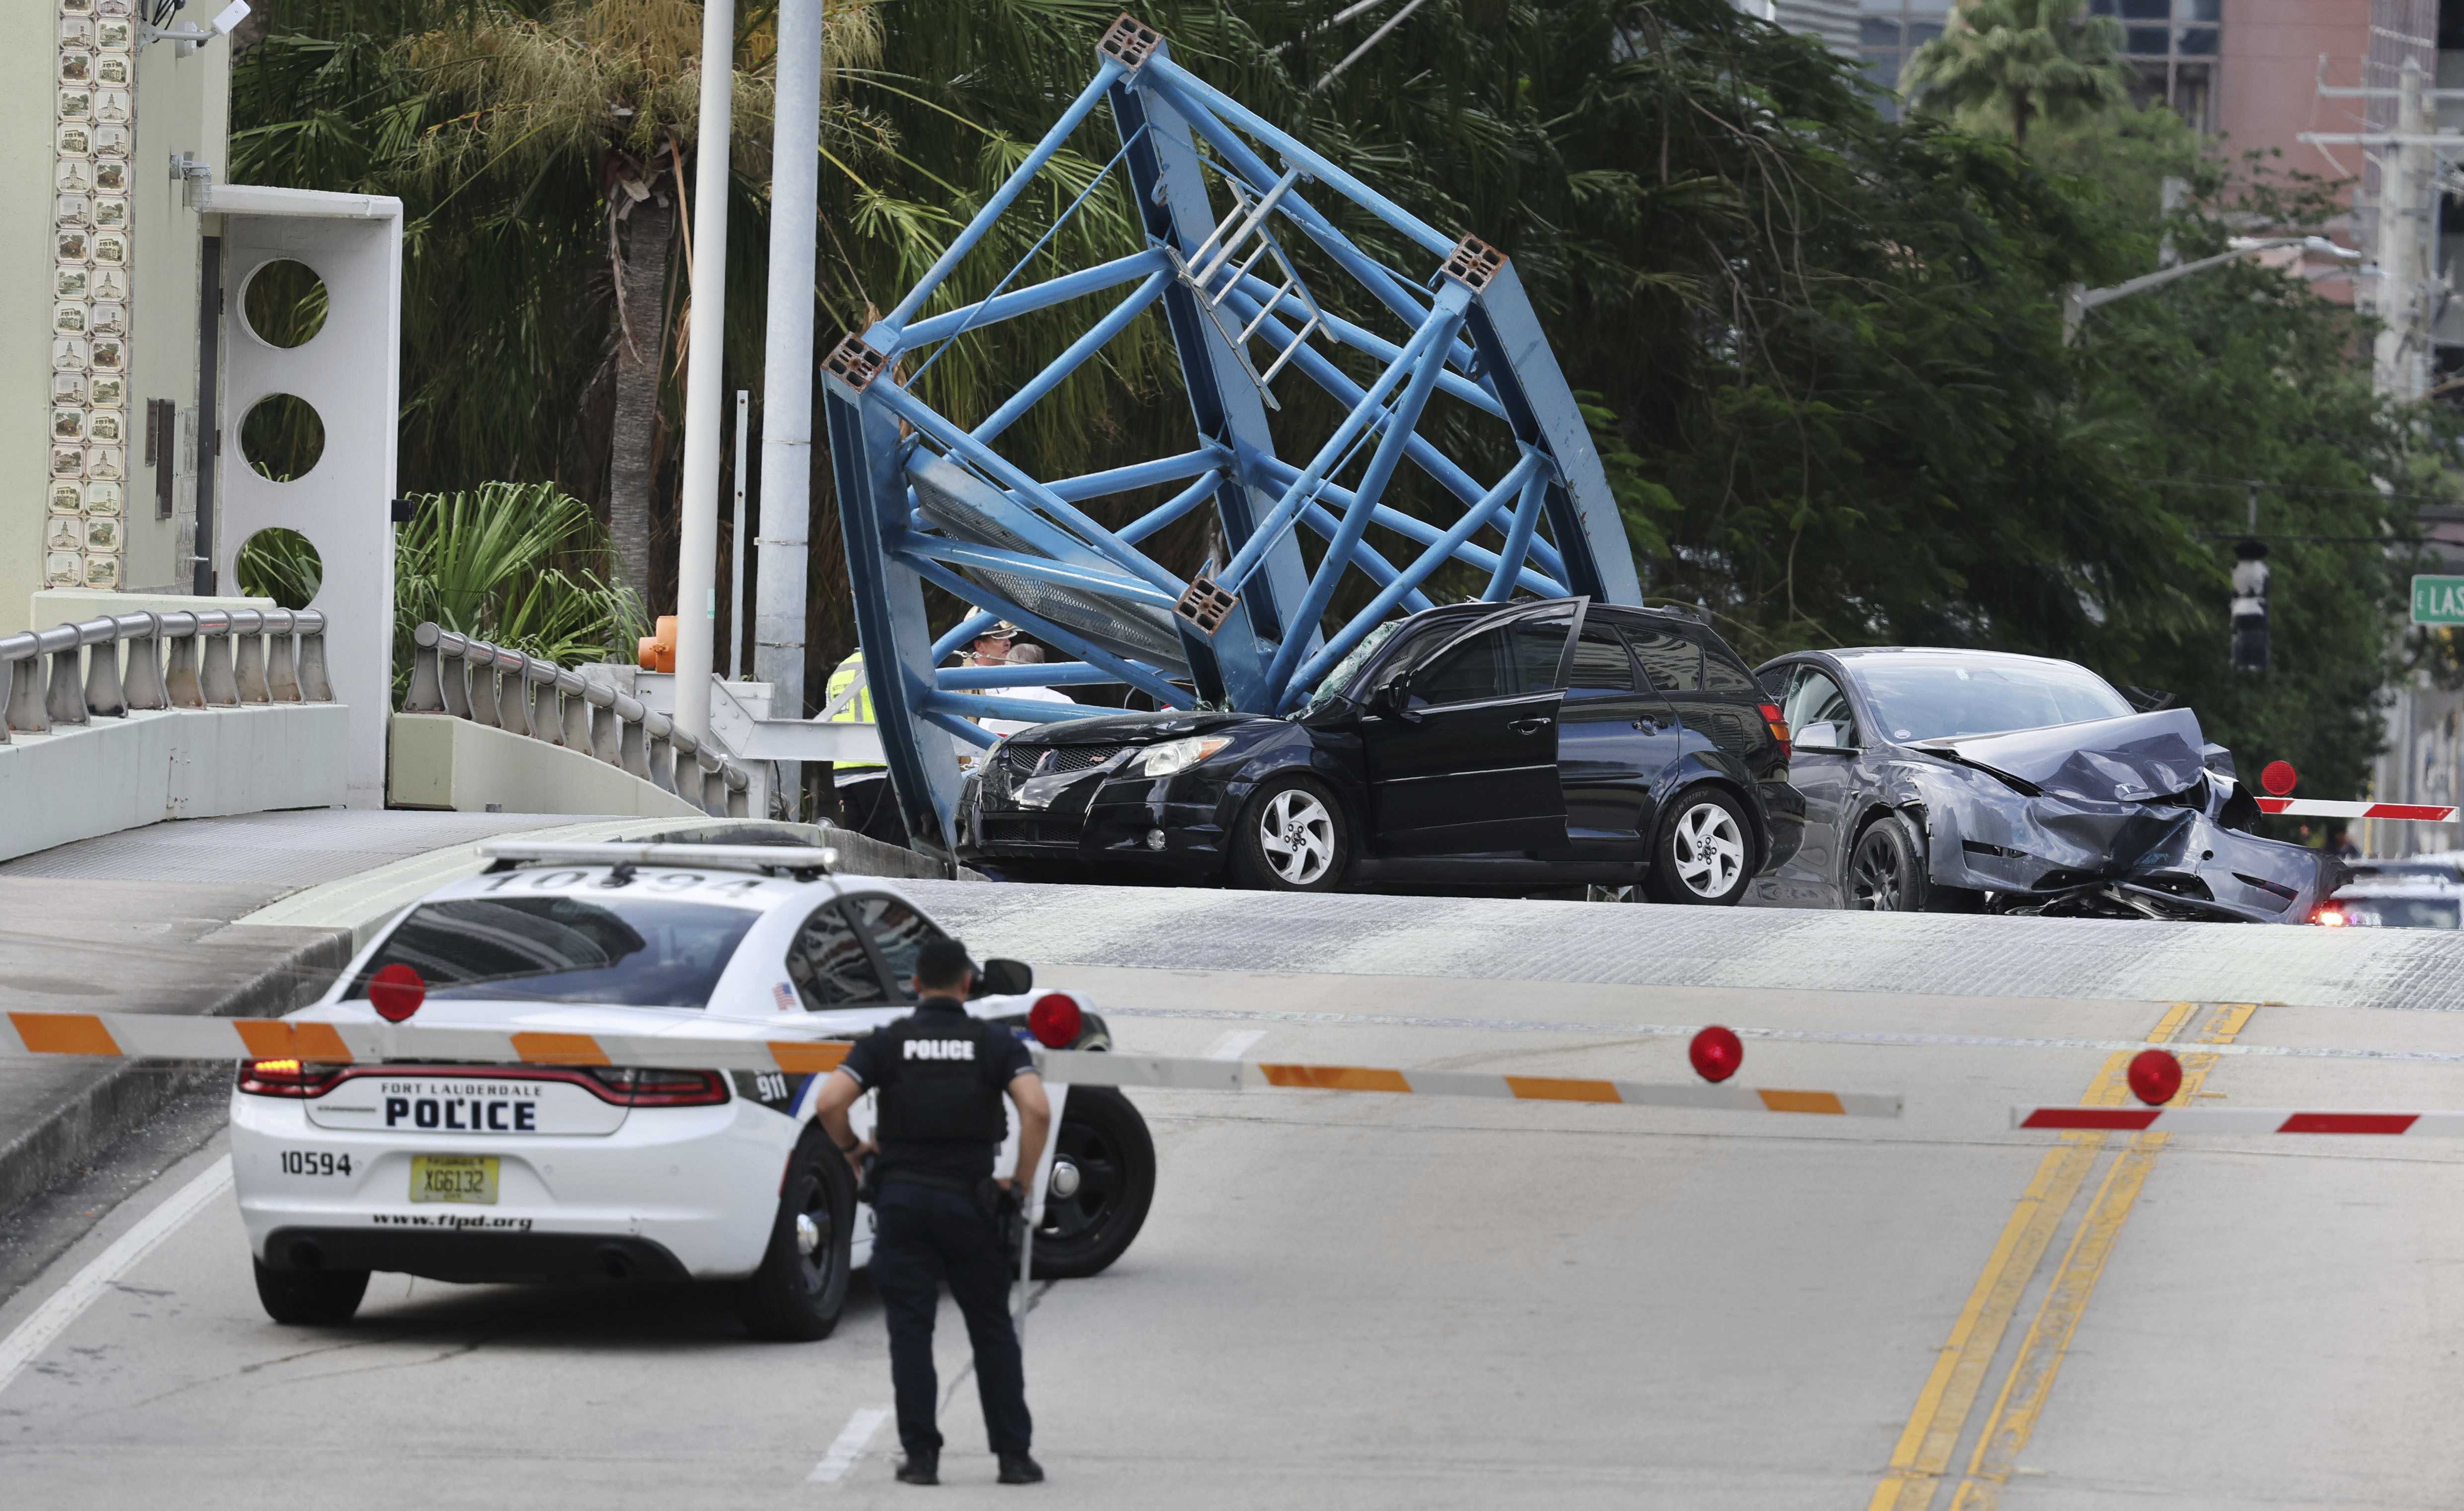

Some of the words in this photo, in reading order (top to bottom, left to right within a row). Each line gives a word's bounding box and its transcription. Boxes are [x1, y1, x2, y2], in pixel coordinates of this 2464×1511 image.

[903, 1039, 975, 1060] POLICE
[381, 1082, 422, 1093] FORT
[431, 1083, 542, 1096] LAUDERDALE
[756, 1073, 788, 1102] 911
[386, 1097, 535, 1131] POLICE
[281, 1151, 352, 1176] 10594
[424, 1168, 484, 1193] XG6132
[373, 1214, 533, 1232] www.flpd.org
